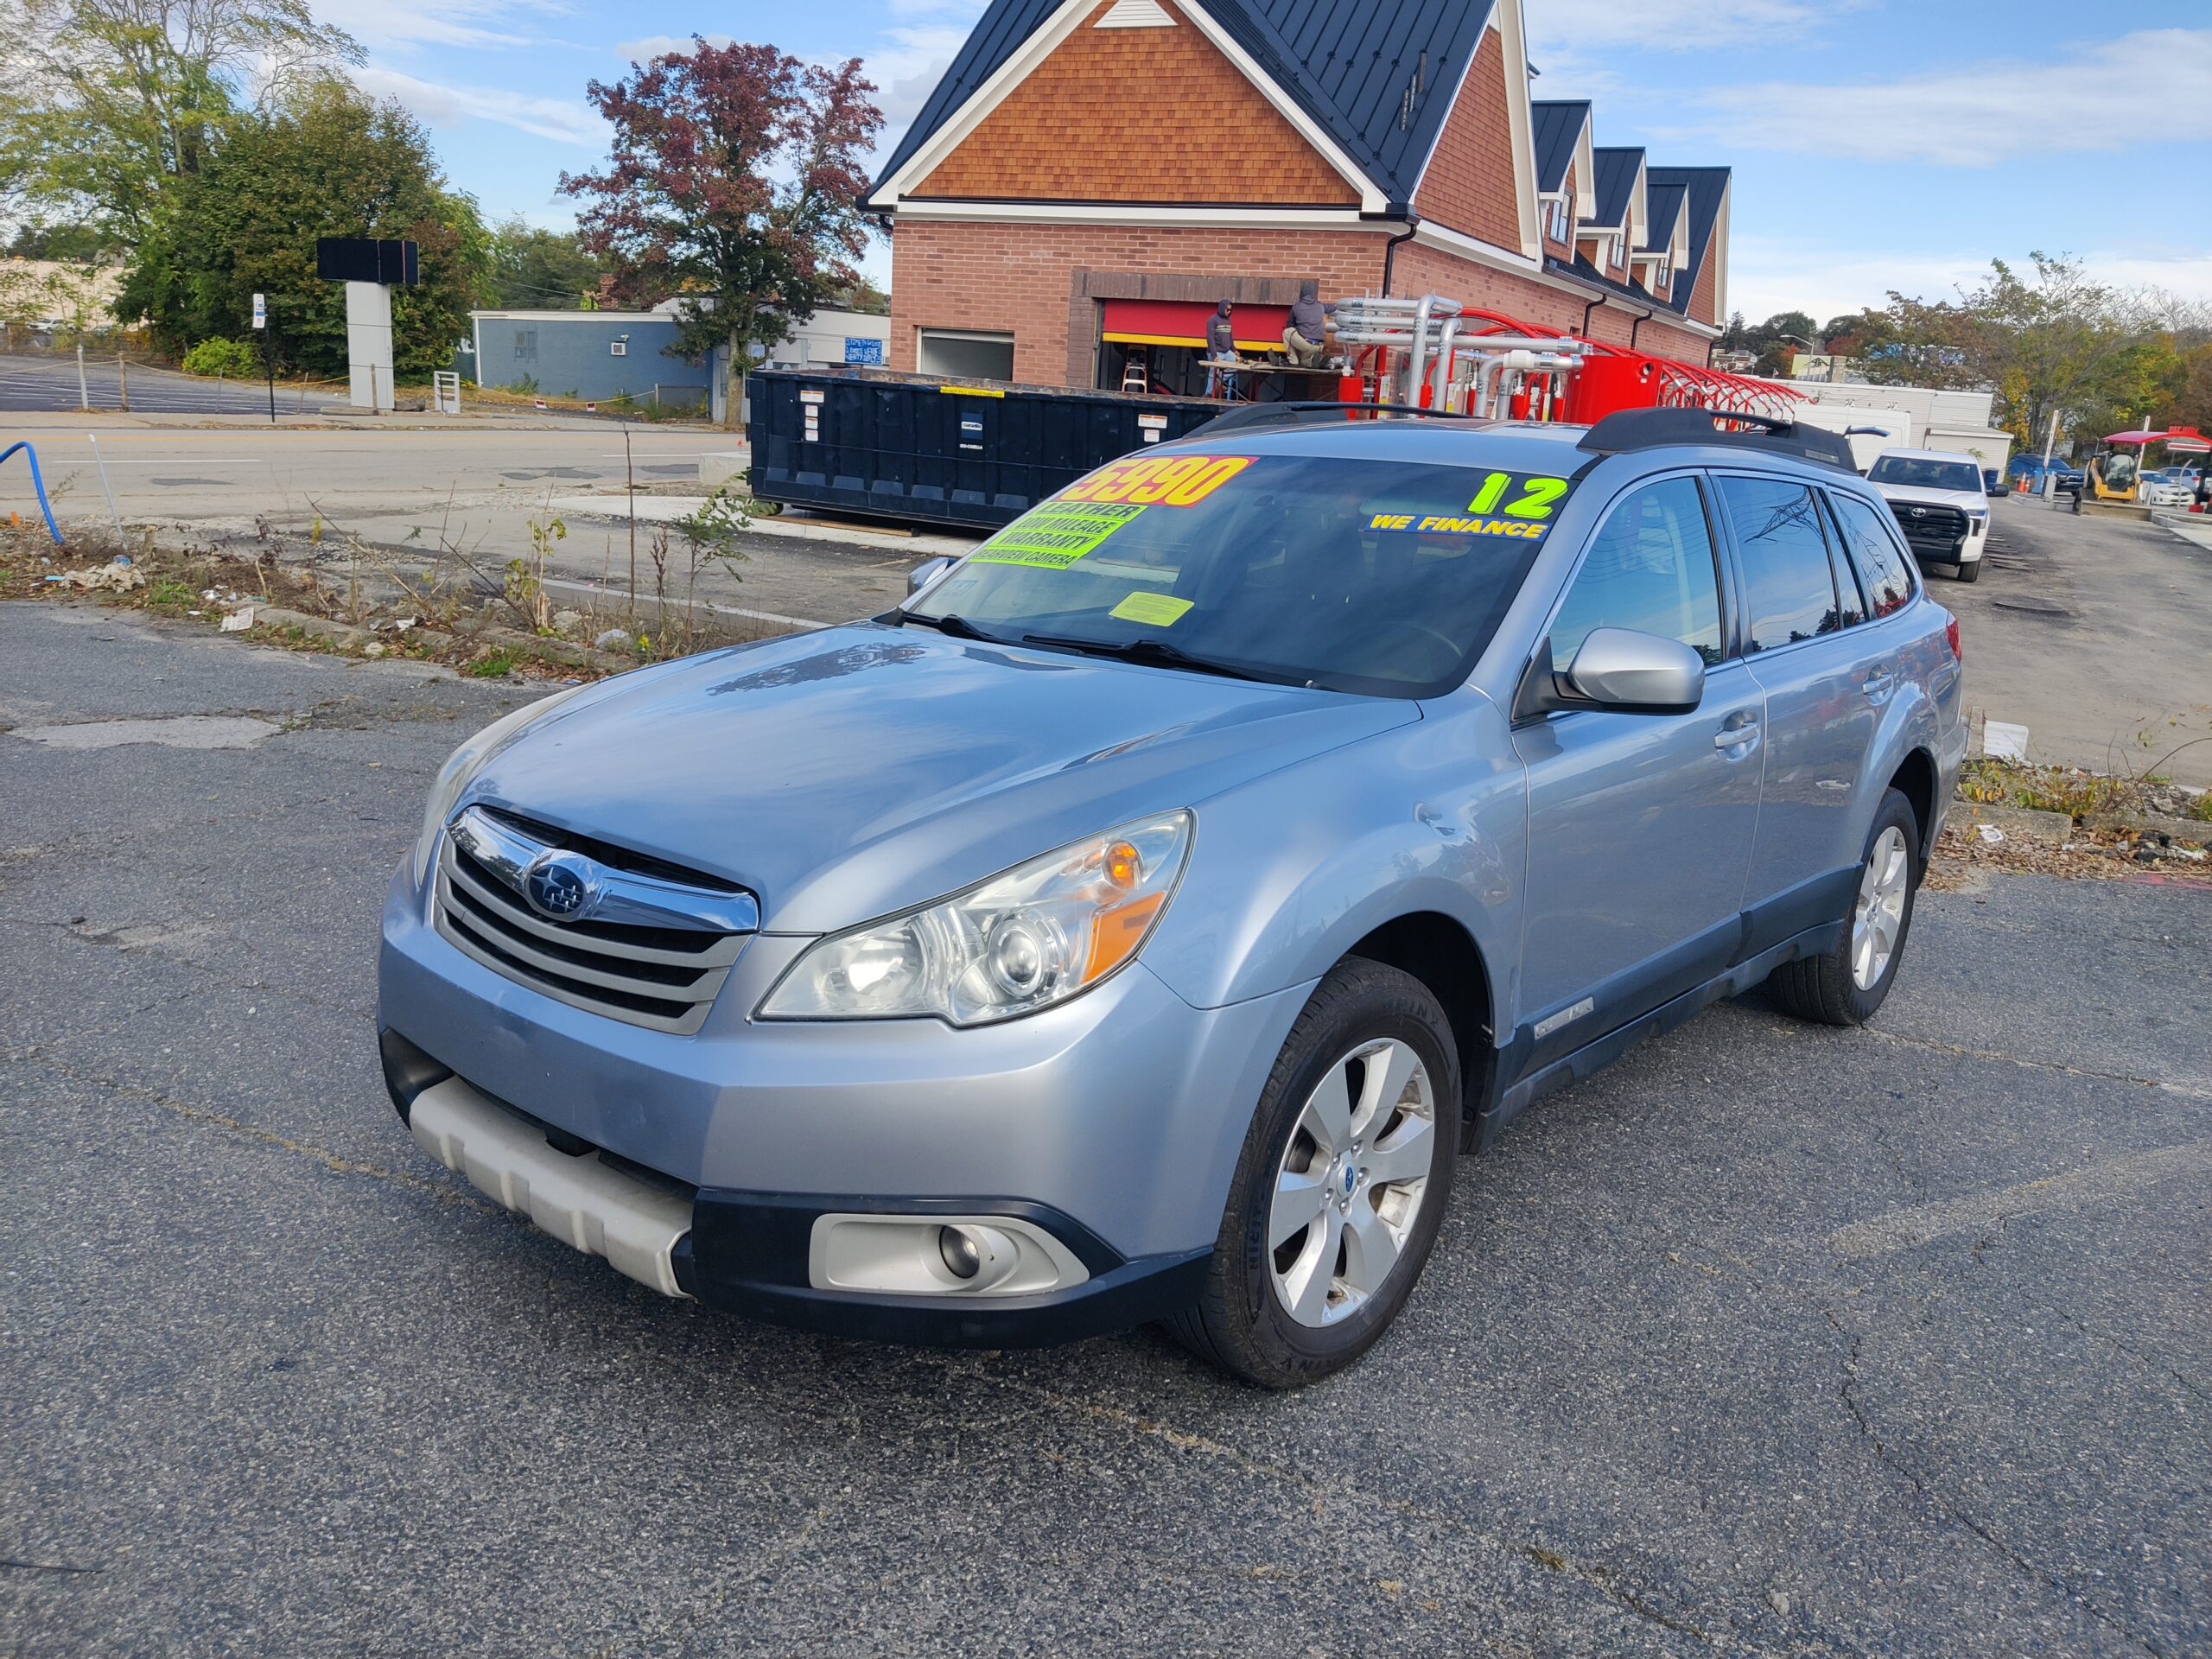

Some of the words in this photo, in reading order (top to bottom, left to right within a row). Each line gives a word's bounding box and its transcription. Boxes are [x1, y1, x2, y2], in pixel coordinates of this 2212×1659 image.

[1061, 456, 1249, 506] 5990
[1467, 473, 1569, 519] 12
[1039, 503, 1141, 518] LEATHER
[1015, 518, 1045, 529] LOW
[1042, 518, 1119, 536] MILEAGE
[1370, 513, 1415, 530] WE
[1417, 516, 1548, 540] FINANCE
[999, 531, 1096, 550] WARRANTY
[1023, 552, 1077, 565] CAMERA
